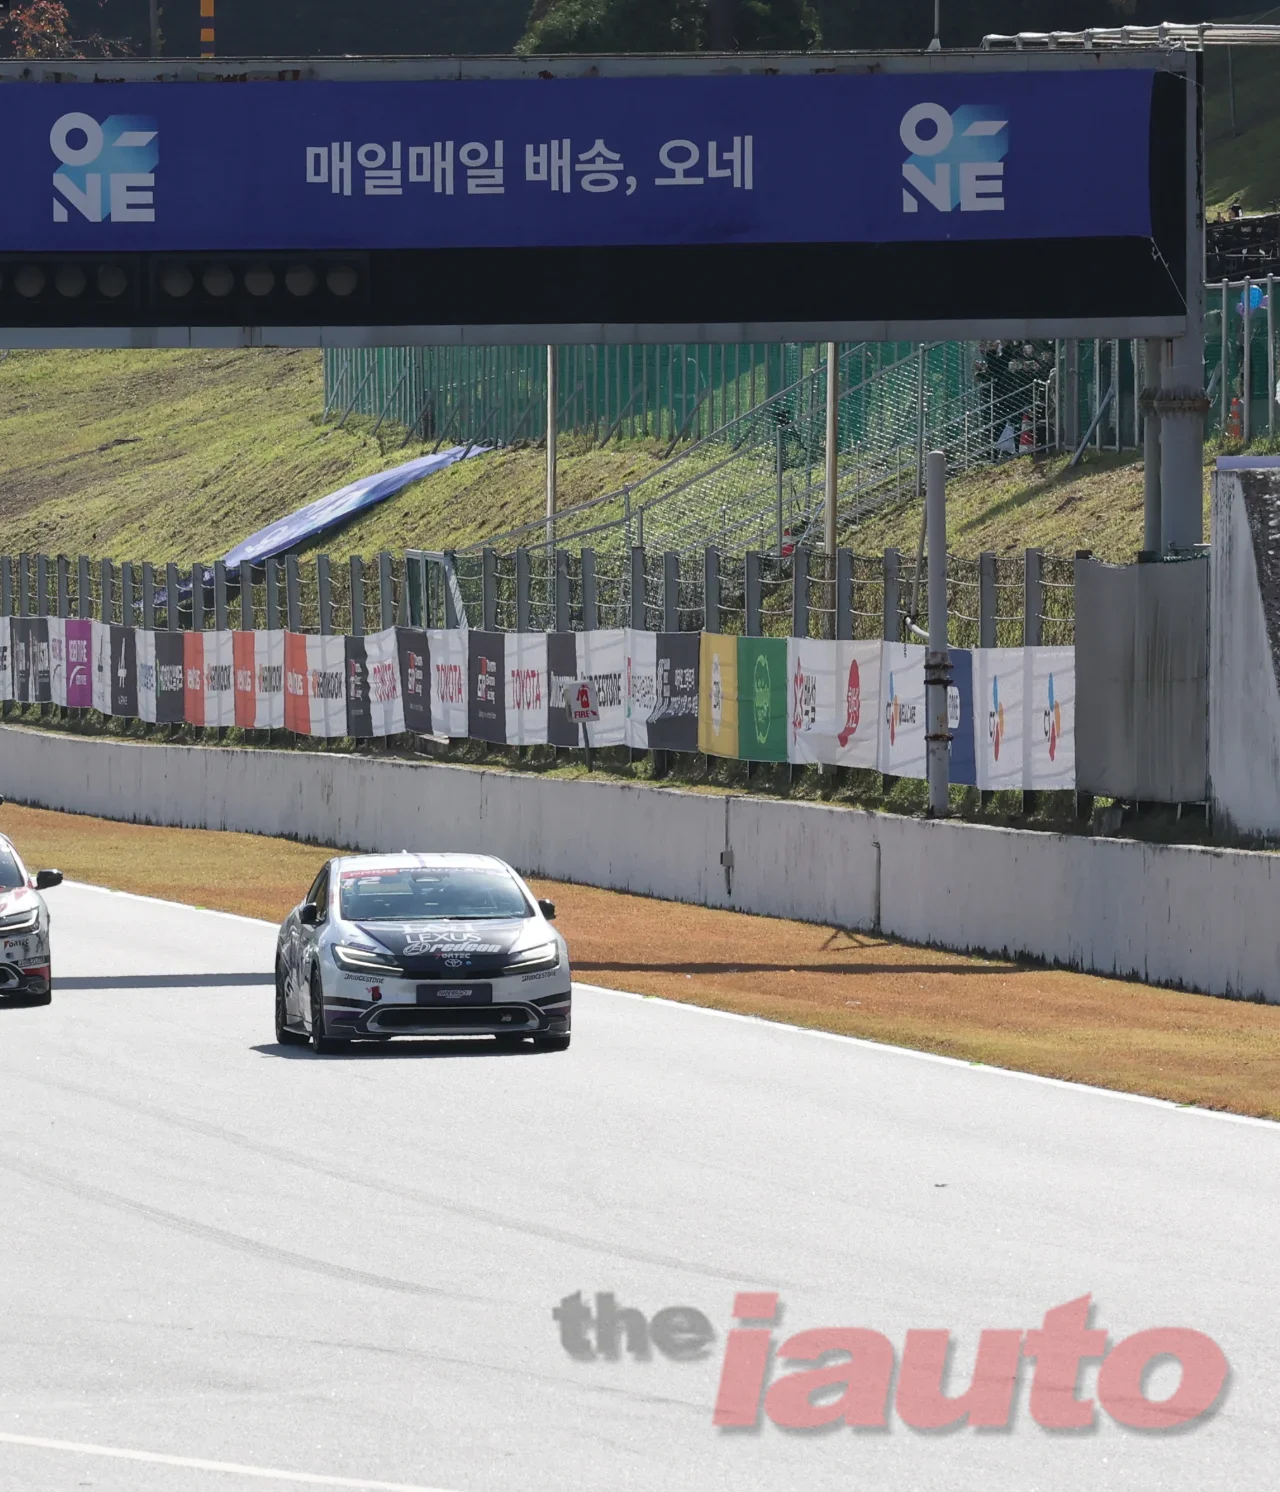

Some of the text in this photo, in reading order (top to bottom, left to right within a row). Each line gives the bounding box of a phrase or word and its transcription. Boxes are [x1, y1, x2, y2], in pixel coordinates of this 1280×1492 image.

[306, 134, 754, 196] 매일매일 배송, 오네
[436, 664, 464, 704] TOYOTA
[511, 669, 542, 710] TOYOTA
[574, 709, 590, 719] FIRE
[405, 931, 482, 944] LEXUS
